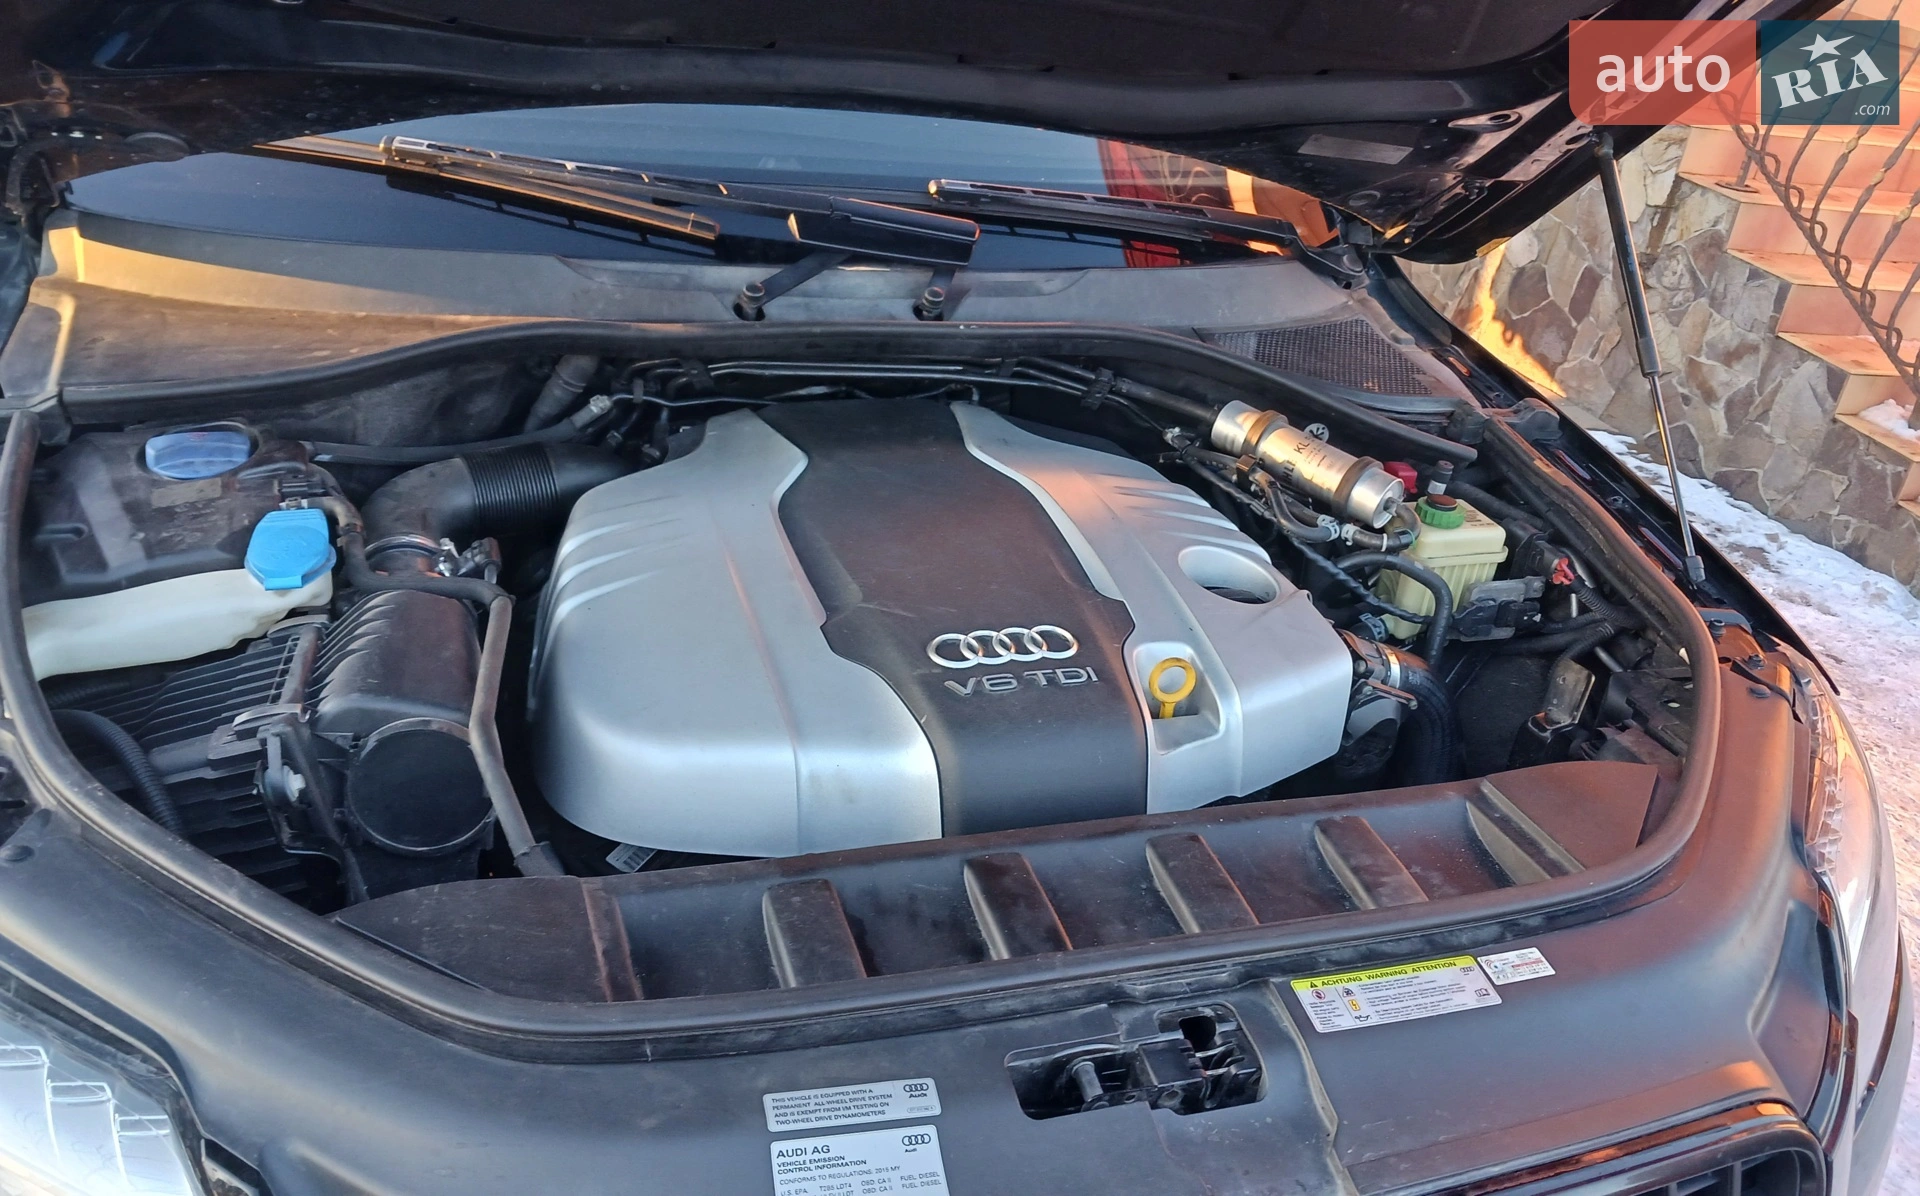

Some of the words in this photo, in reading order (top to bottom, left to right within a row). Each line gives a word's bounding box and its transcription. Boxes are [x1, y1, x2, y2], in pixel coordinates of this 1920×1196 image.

[943, 673, 1018, 697] V6
[1023, 666, 1099, 688] TDI
[1321, 976, 1363, 987] ACHTUNG
[1365, 968, 1408, 980] WARNING
[1411, 961, 1457, 973] ATTENTION
[820, 1090, 850, 1098] EQUIPPED
[772, 1102, 810, 1110] PERMANENT
[796, 1108, 822, 1116] EXEMPT
[834, 1110, 886, 1120] DYNAMOMETERS
[776, 1147, 807, 1159] AUDI
[811, 1144, 830, 1155] AG
[776, 1160, 807, 1168] VEHICLE
[808, 1155, 845, 1164] EMISSION
[777, 1166, 813, 1175] CONTROL
[814, 1160, 867, 1170] INFORMATION
[779, 1175, 816, 1186] CONFORMS
[918, 1171, 940, 1179] DIESEL
